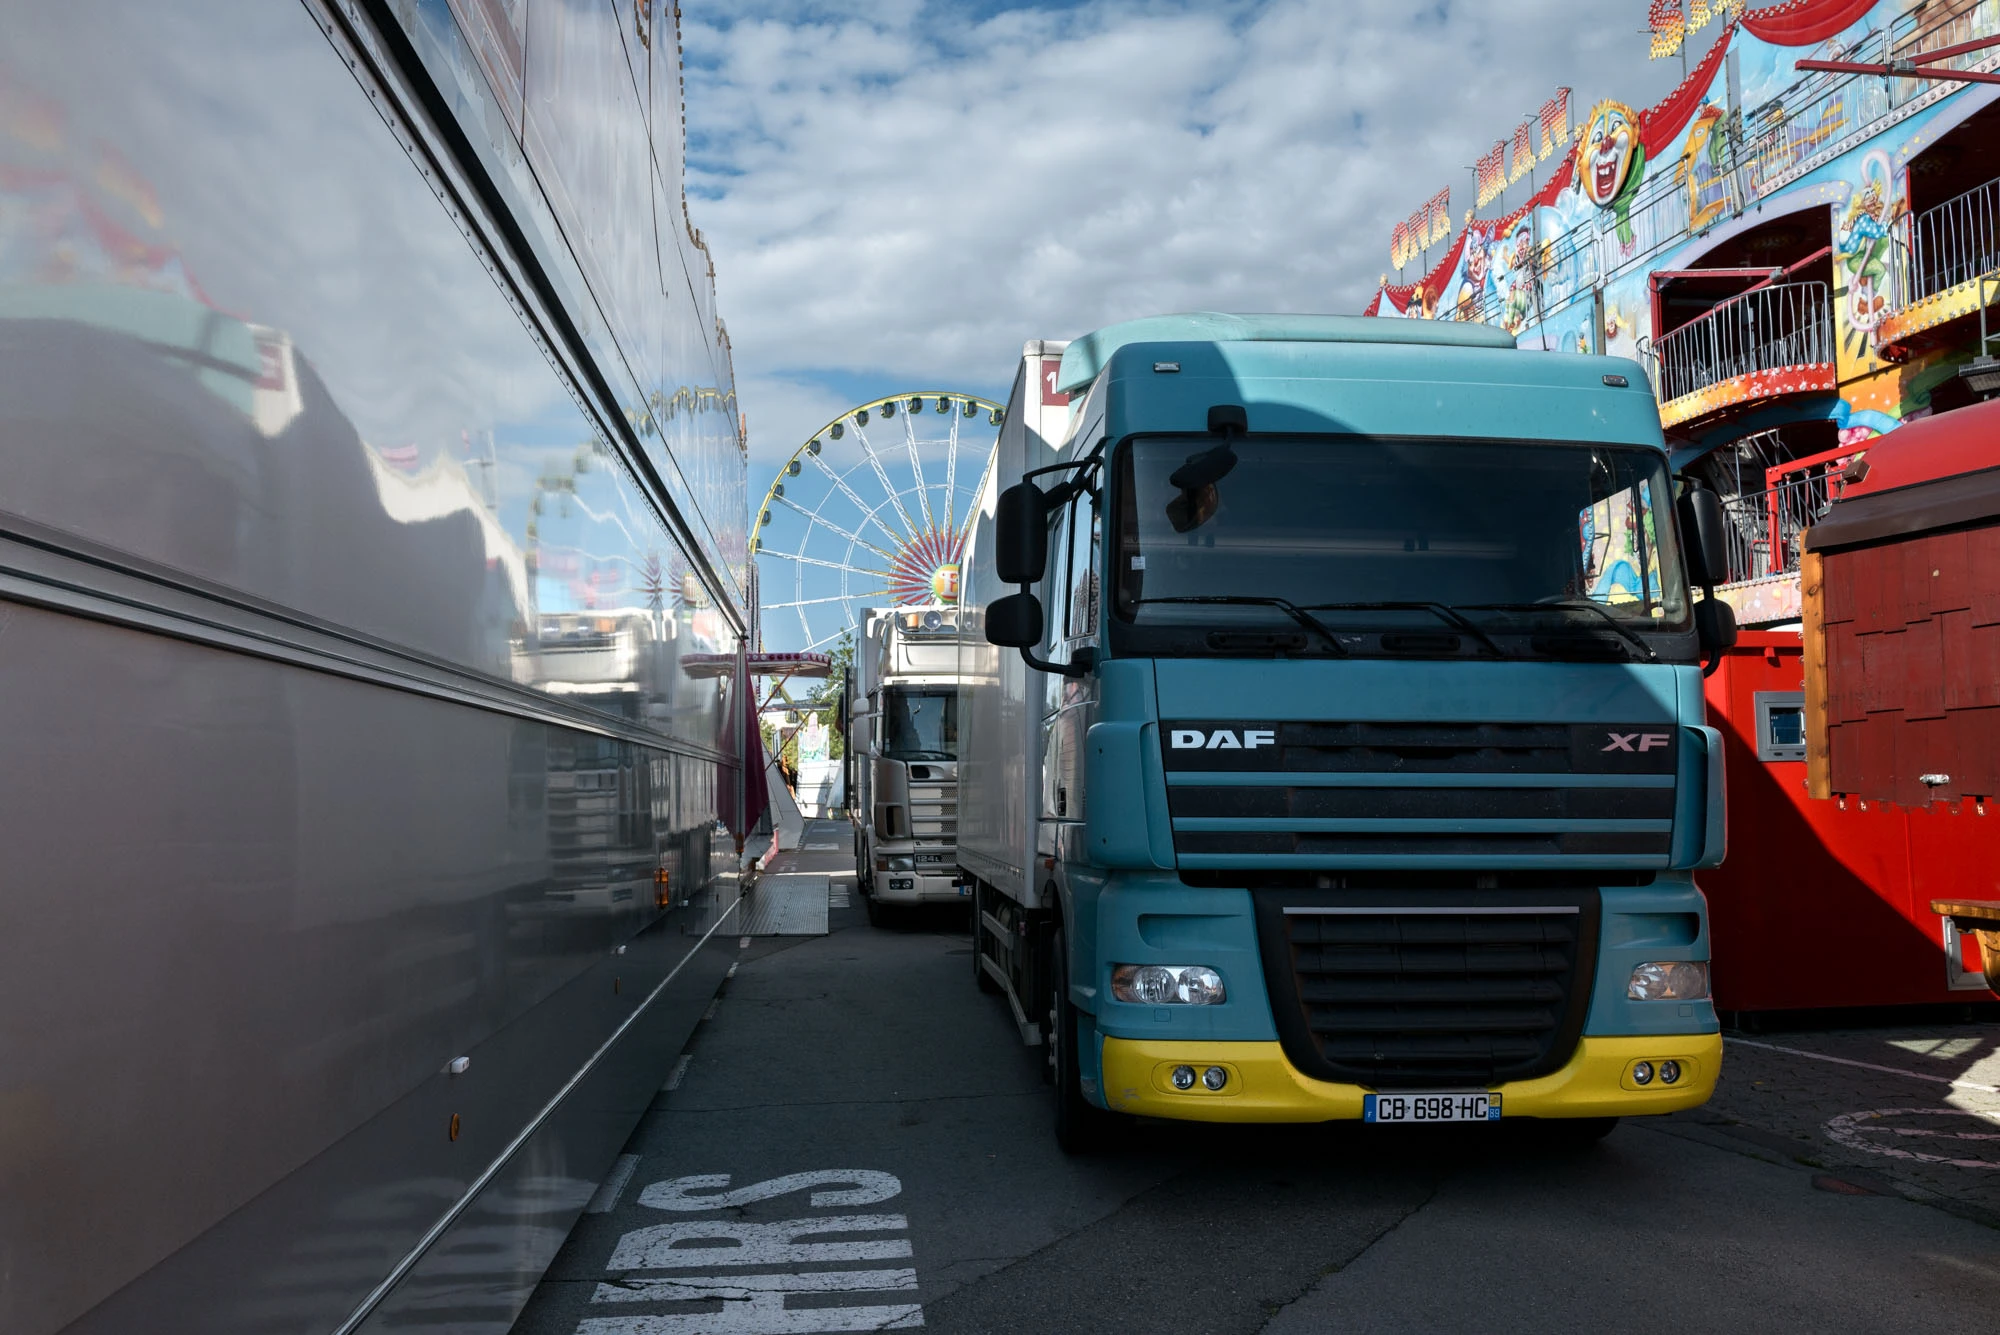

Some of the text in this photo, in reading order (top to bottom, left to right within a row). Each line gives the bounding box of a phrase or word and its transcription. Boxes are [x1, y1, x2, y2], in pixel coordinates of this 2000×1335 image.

[1391, 185, 1451, 271] ONE
[1475, 87, 1571, 210] MAN
[1171, 730, 1275, 749] DAF
[1601, 733, 1670, 752] XF
